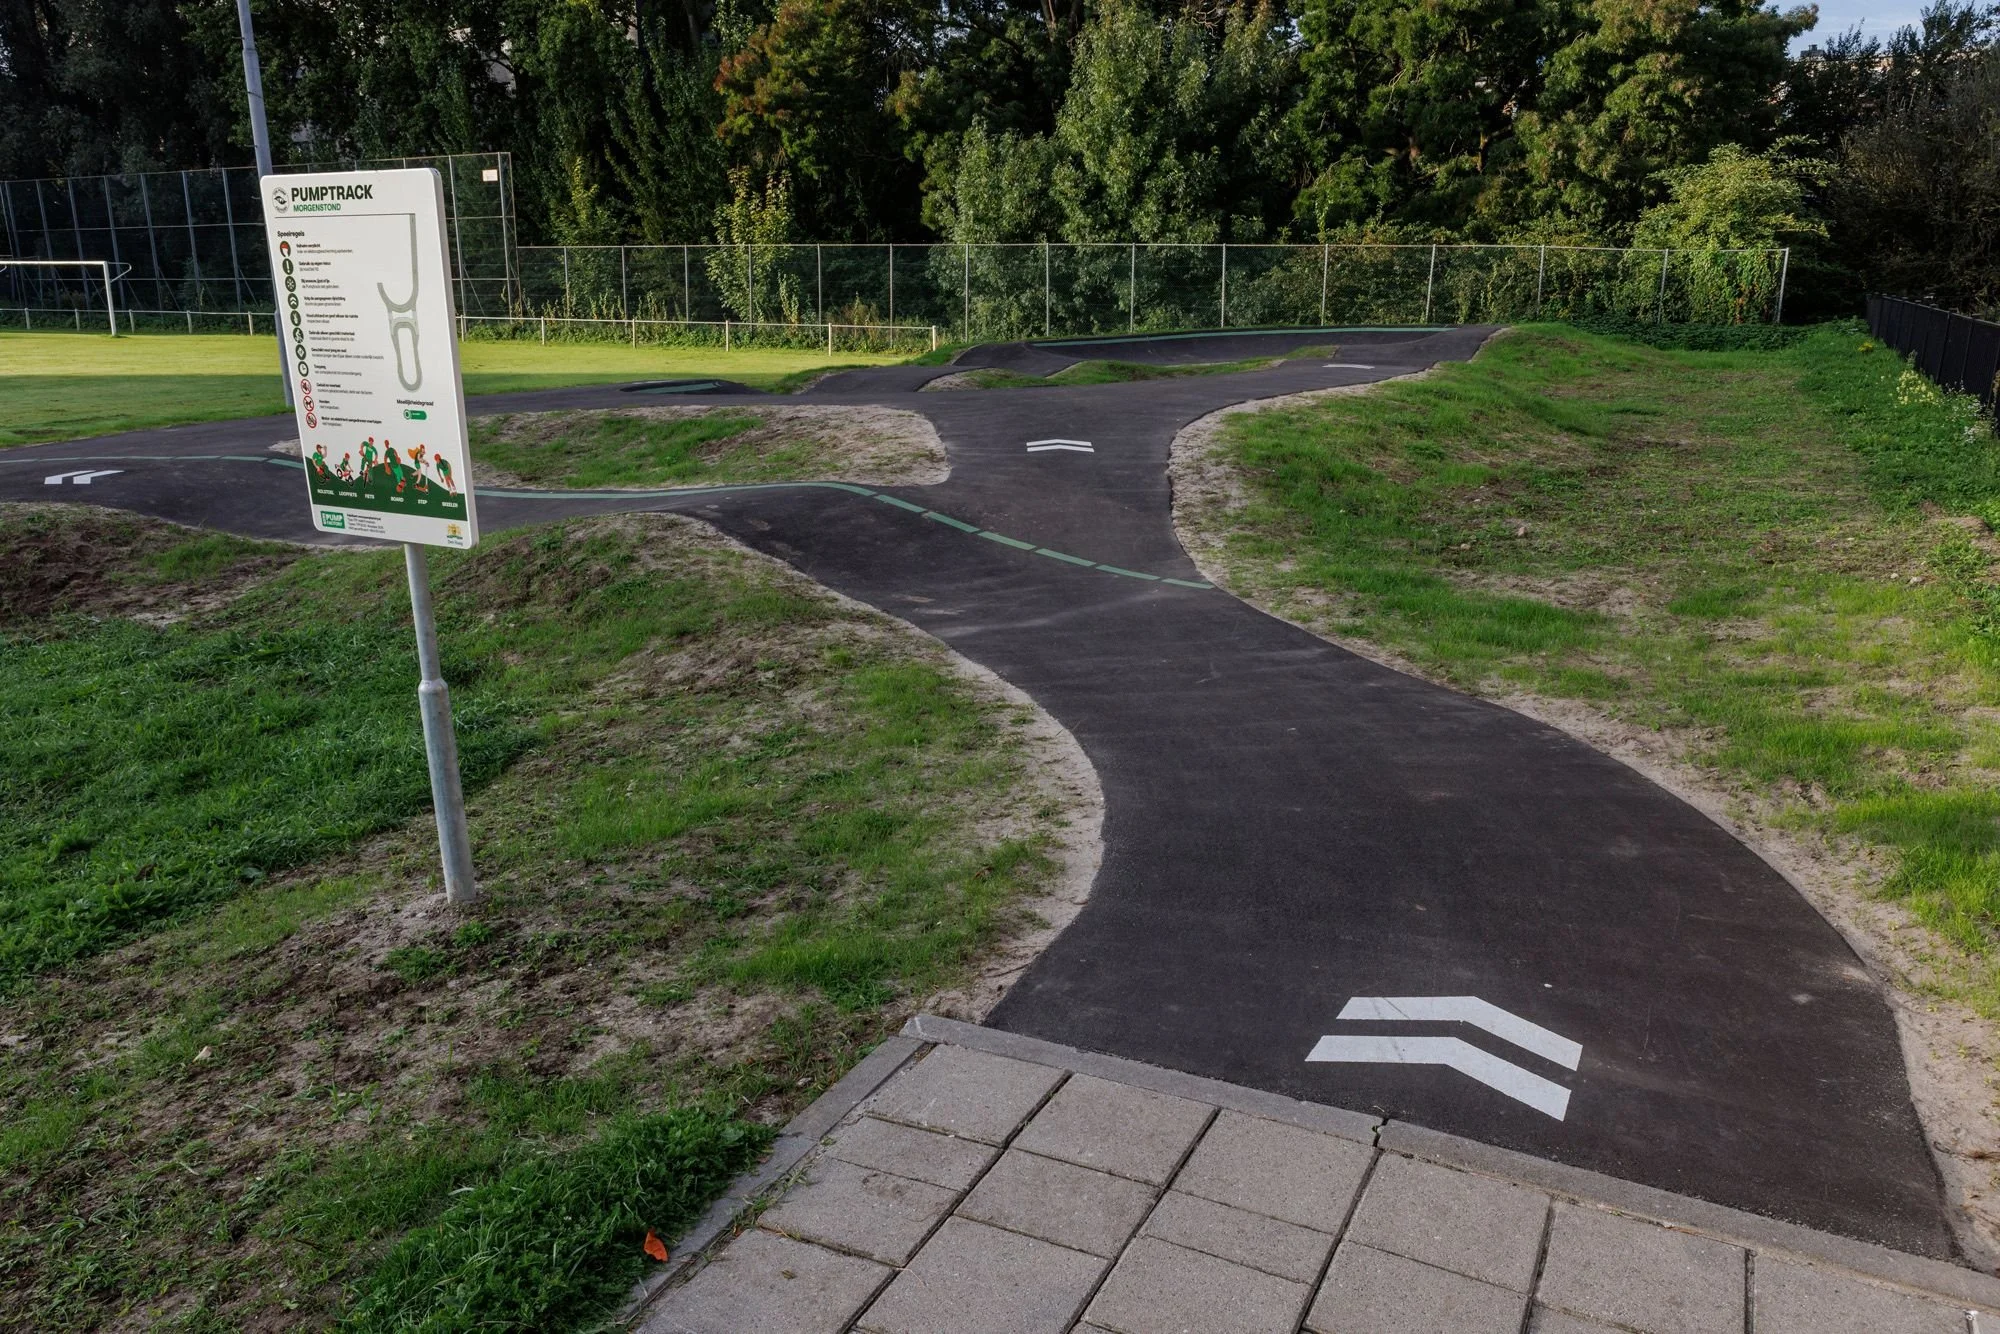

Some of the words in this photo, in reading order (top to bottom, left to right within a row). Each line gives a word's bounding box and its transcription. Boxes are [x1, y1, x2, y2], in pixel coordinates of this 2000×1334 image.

[292, 184, 373, 202] PUMPTRACK
[294, 204, 341, 212] MORGENSTOND
[326, 513, 342, 521] PUMP
